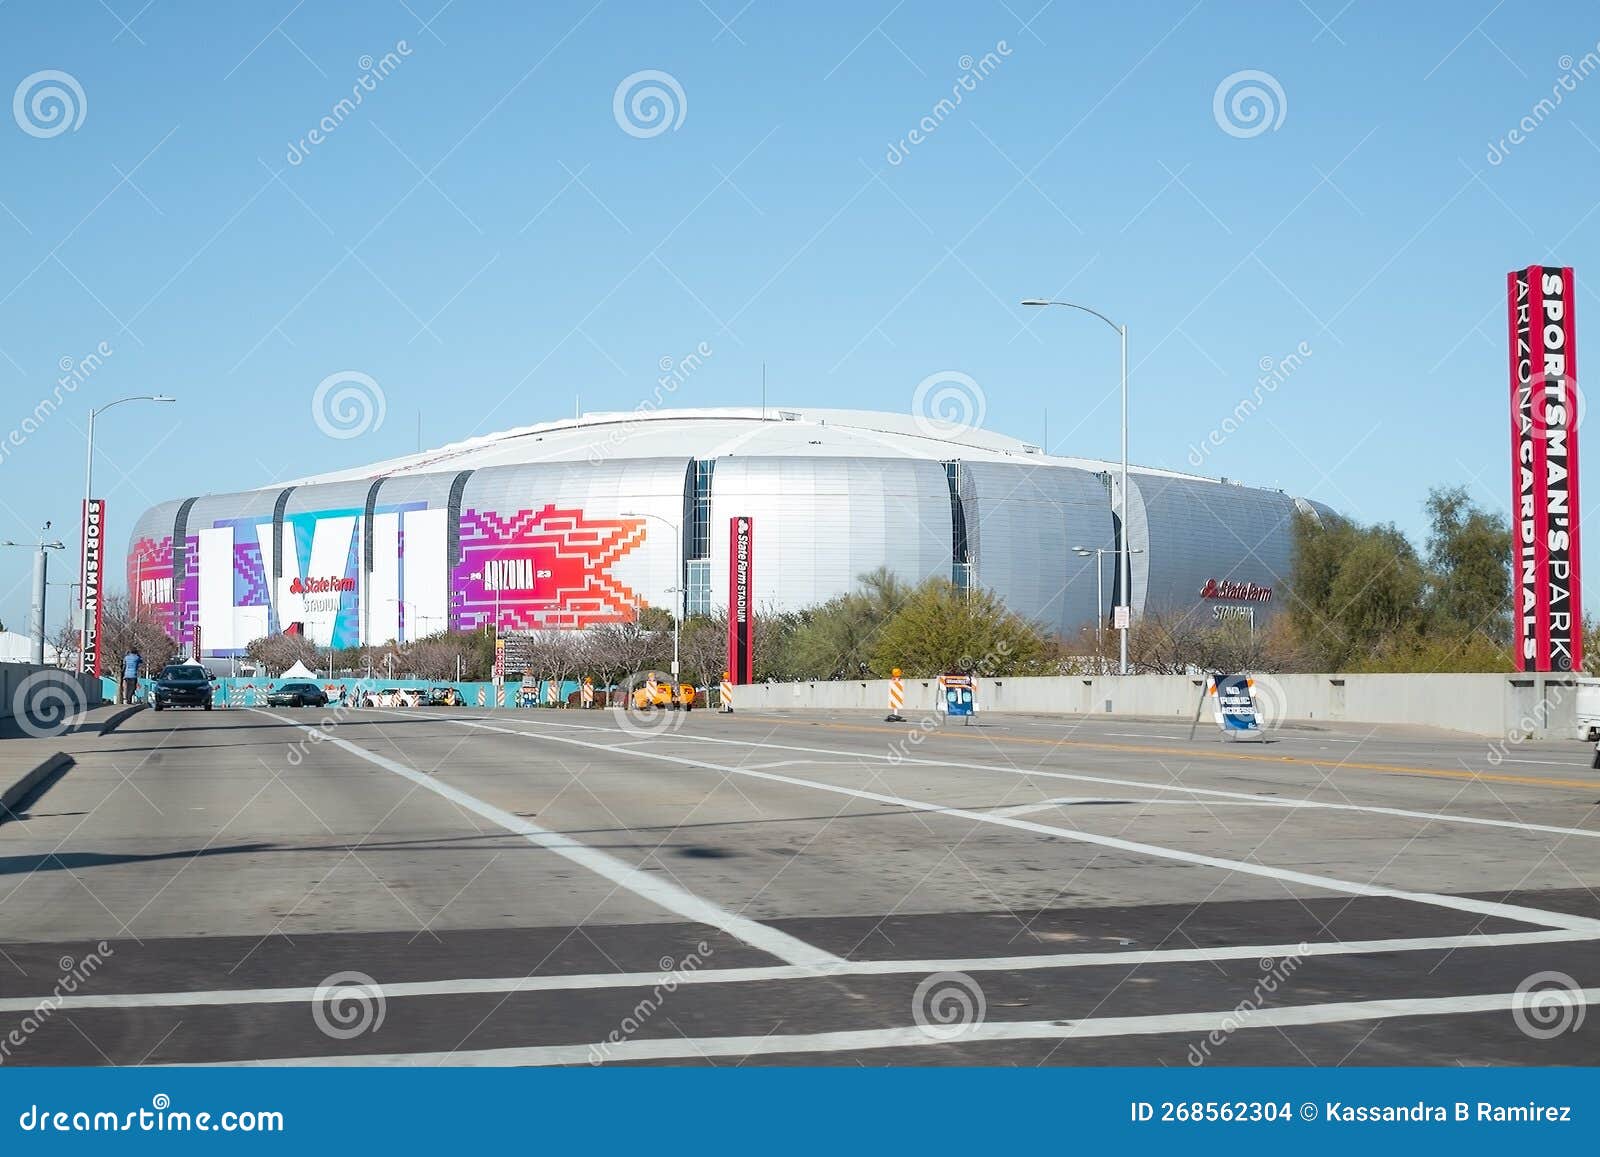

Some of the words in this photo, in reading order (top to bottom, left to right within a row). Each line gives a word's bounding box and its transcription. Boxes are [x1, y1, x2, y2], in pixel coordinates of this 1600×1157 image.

[1516, 279, 1532, 436] ARIZONA
[1542, 273, 1569, 552] SPORTSMAN'S
[86, 501, 99, 626] SPORTSMAN
[484, 558, 535, 591] ARIZONA
[737, 585, 747, 623] STADIUM
[1520, 439, 1537, 660] CARDINALS
[84, 629, 97, 674] PARK
[1548, 560, 1572, 658] PARK
